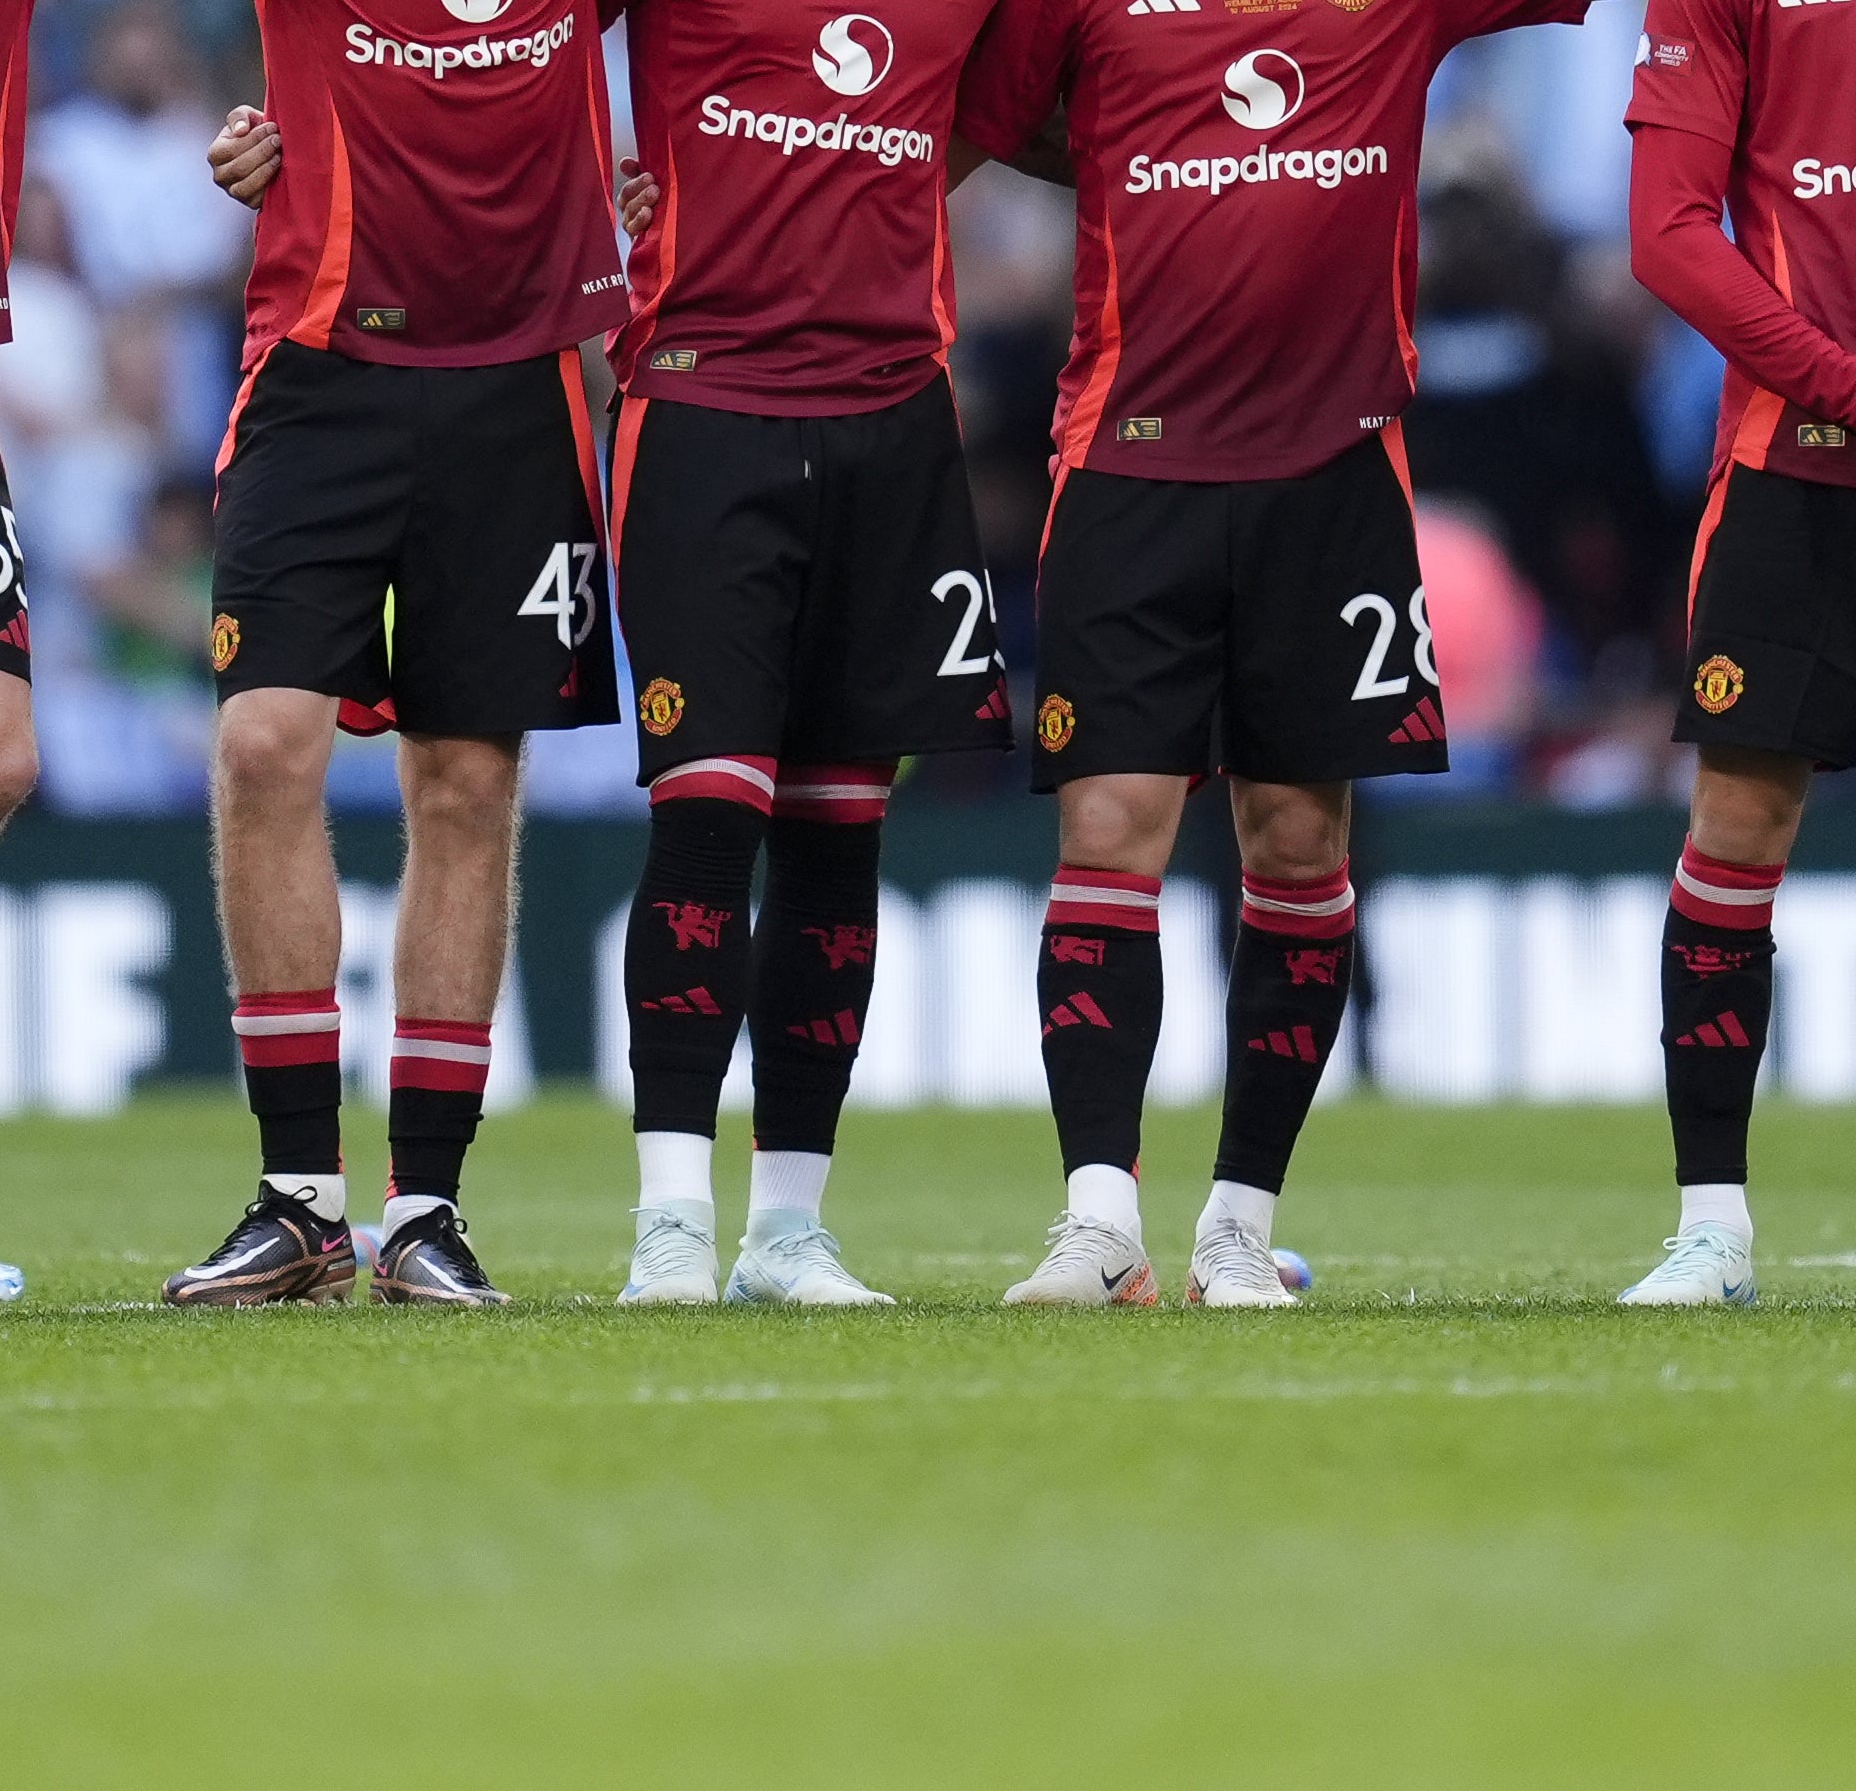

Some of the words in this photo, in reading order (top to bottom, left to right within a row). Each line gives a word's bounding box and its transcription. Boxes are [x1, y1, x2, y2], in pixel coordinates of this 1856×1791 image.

[345, 13, 574, 79] Snapdragon
[698, 95, 933, 167] Snapdragon
[1125, 144, 1387, 195] Snapdragon
[516, 542, 597, 650] 43
[931, 569, 1006, 676] 2
